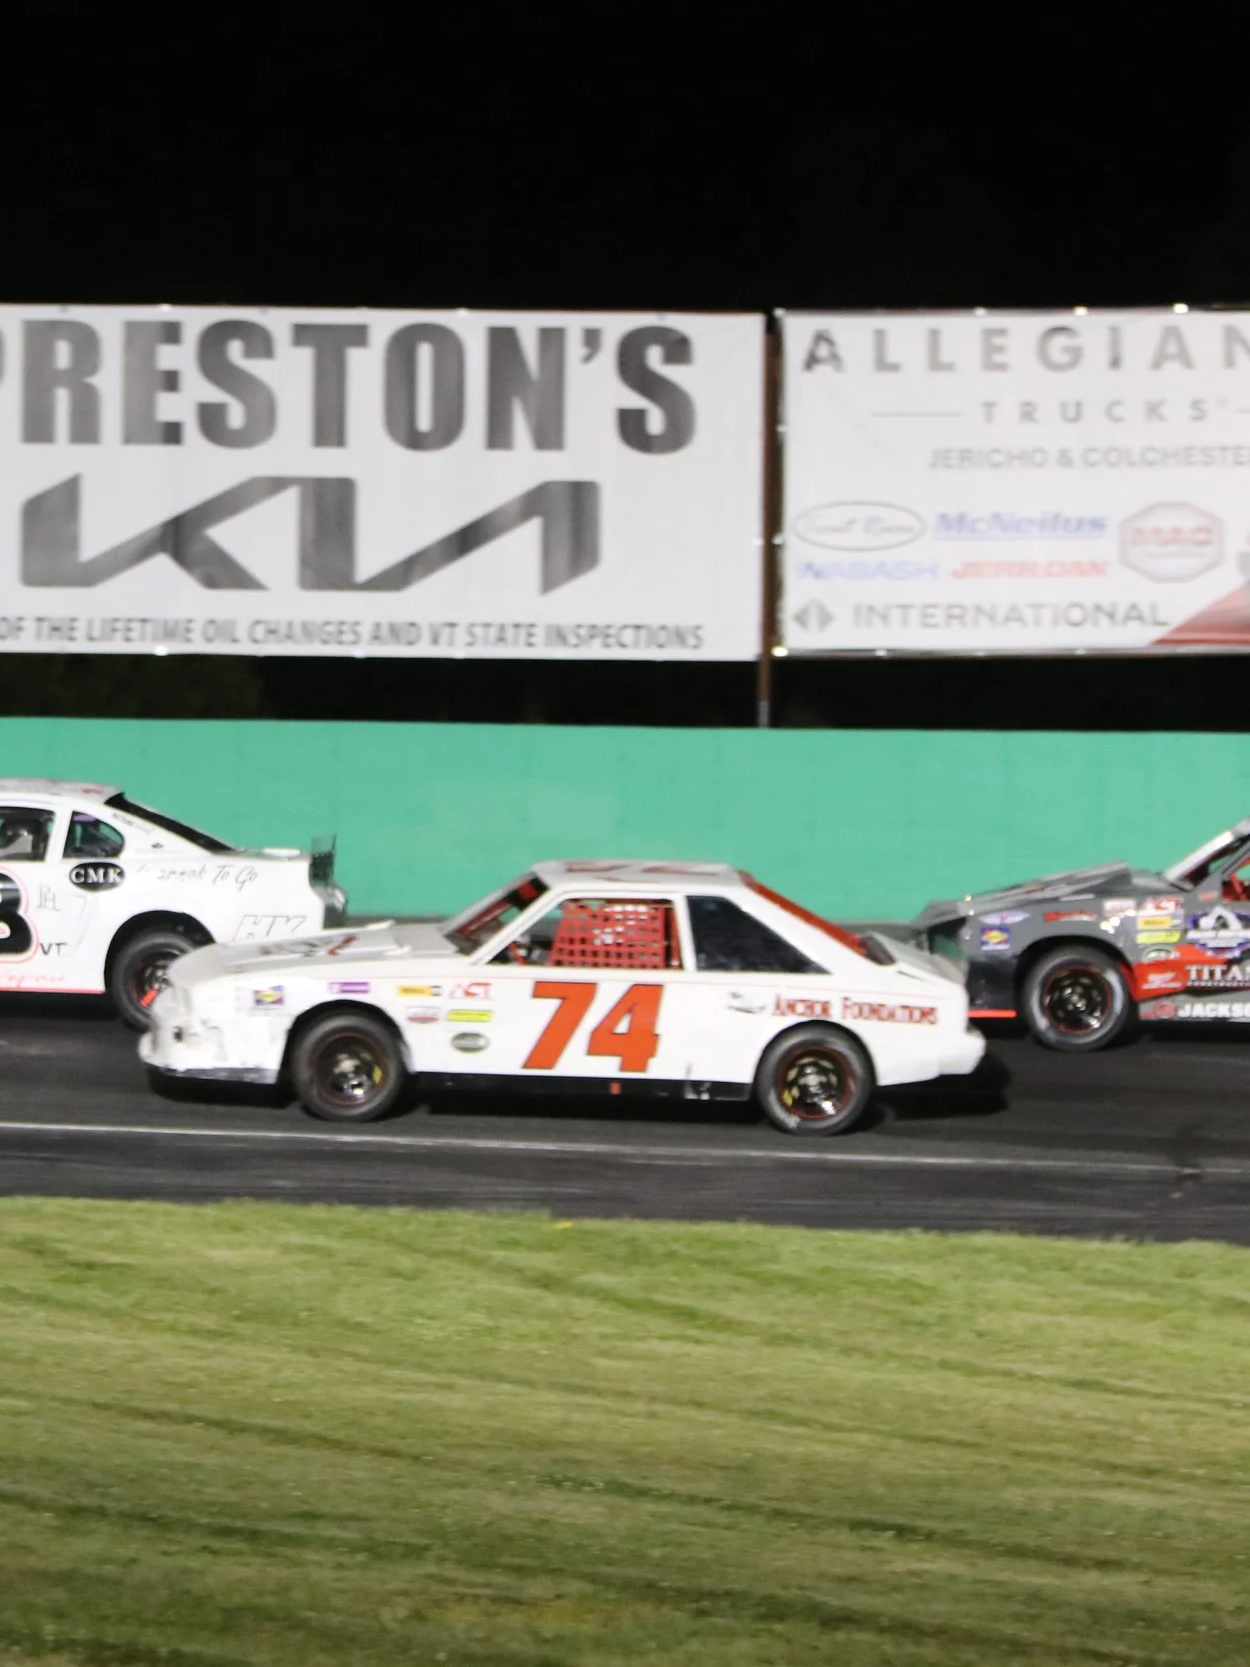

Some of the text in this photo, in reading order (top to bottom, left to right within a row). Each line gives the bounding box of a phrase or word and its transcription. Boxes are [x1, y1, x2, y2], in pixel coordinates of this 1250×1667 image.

[982, 398, 1209, 423] TRUCKS
[929, 446, 1049, 470] JERICHO
[1055, 447, 1076, 469] &
[20, 473, 601, 596] KIA
[934, 511, 1109, 538] McNeilus
[853, 601, 1173, 630] INTERNATIONAL
[33, 616, 79, 642] THE
[86, 616, 195, 644] LIFETIME
[202, 618, 240, 644] OIL
[250, 619, 363, 646] CHANGES
[368, 620, 423, 647] AND
[427, 621, 461, 647] VT
[464, 622, 538, 648] STATE
[544, 623, 704, 649] INSPECTIONS
[521, 980, 665, 1073] 74
